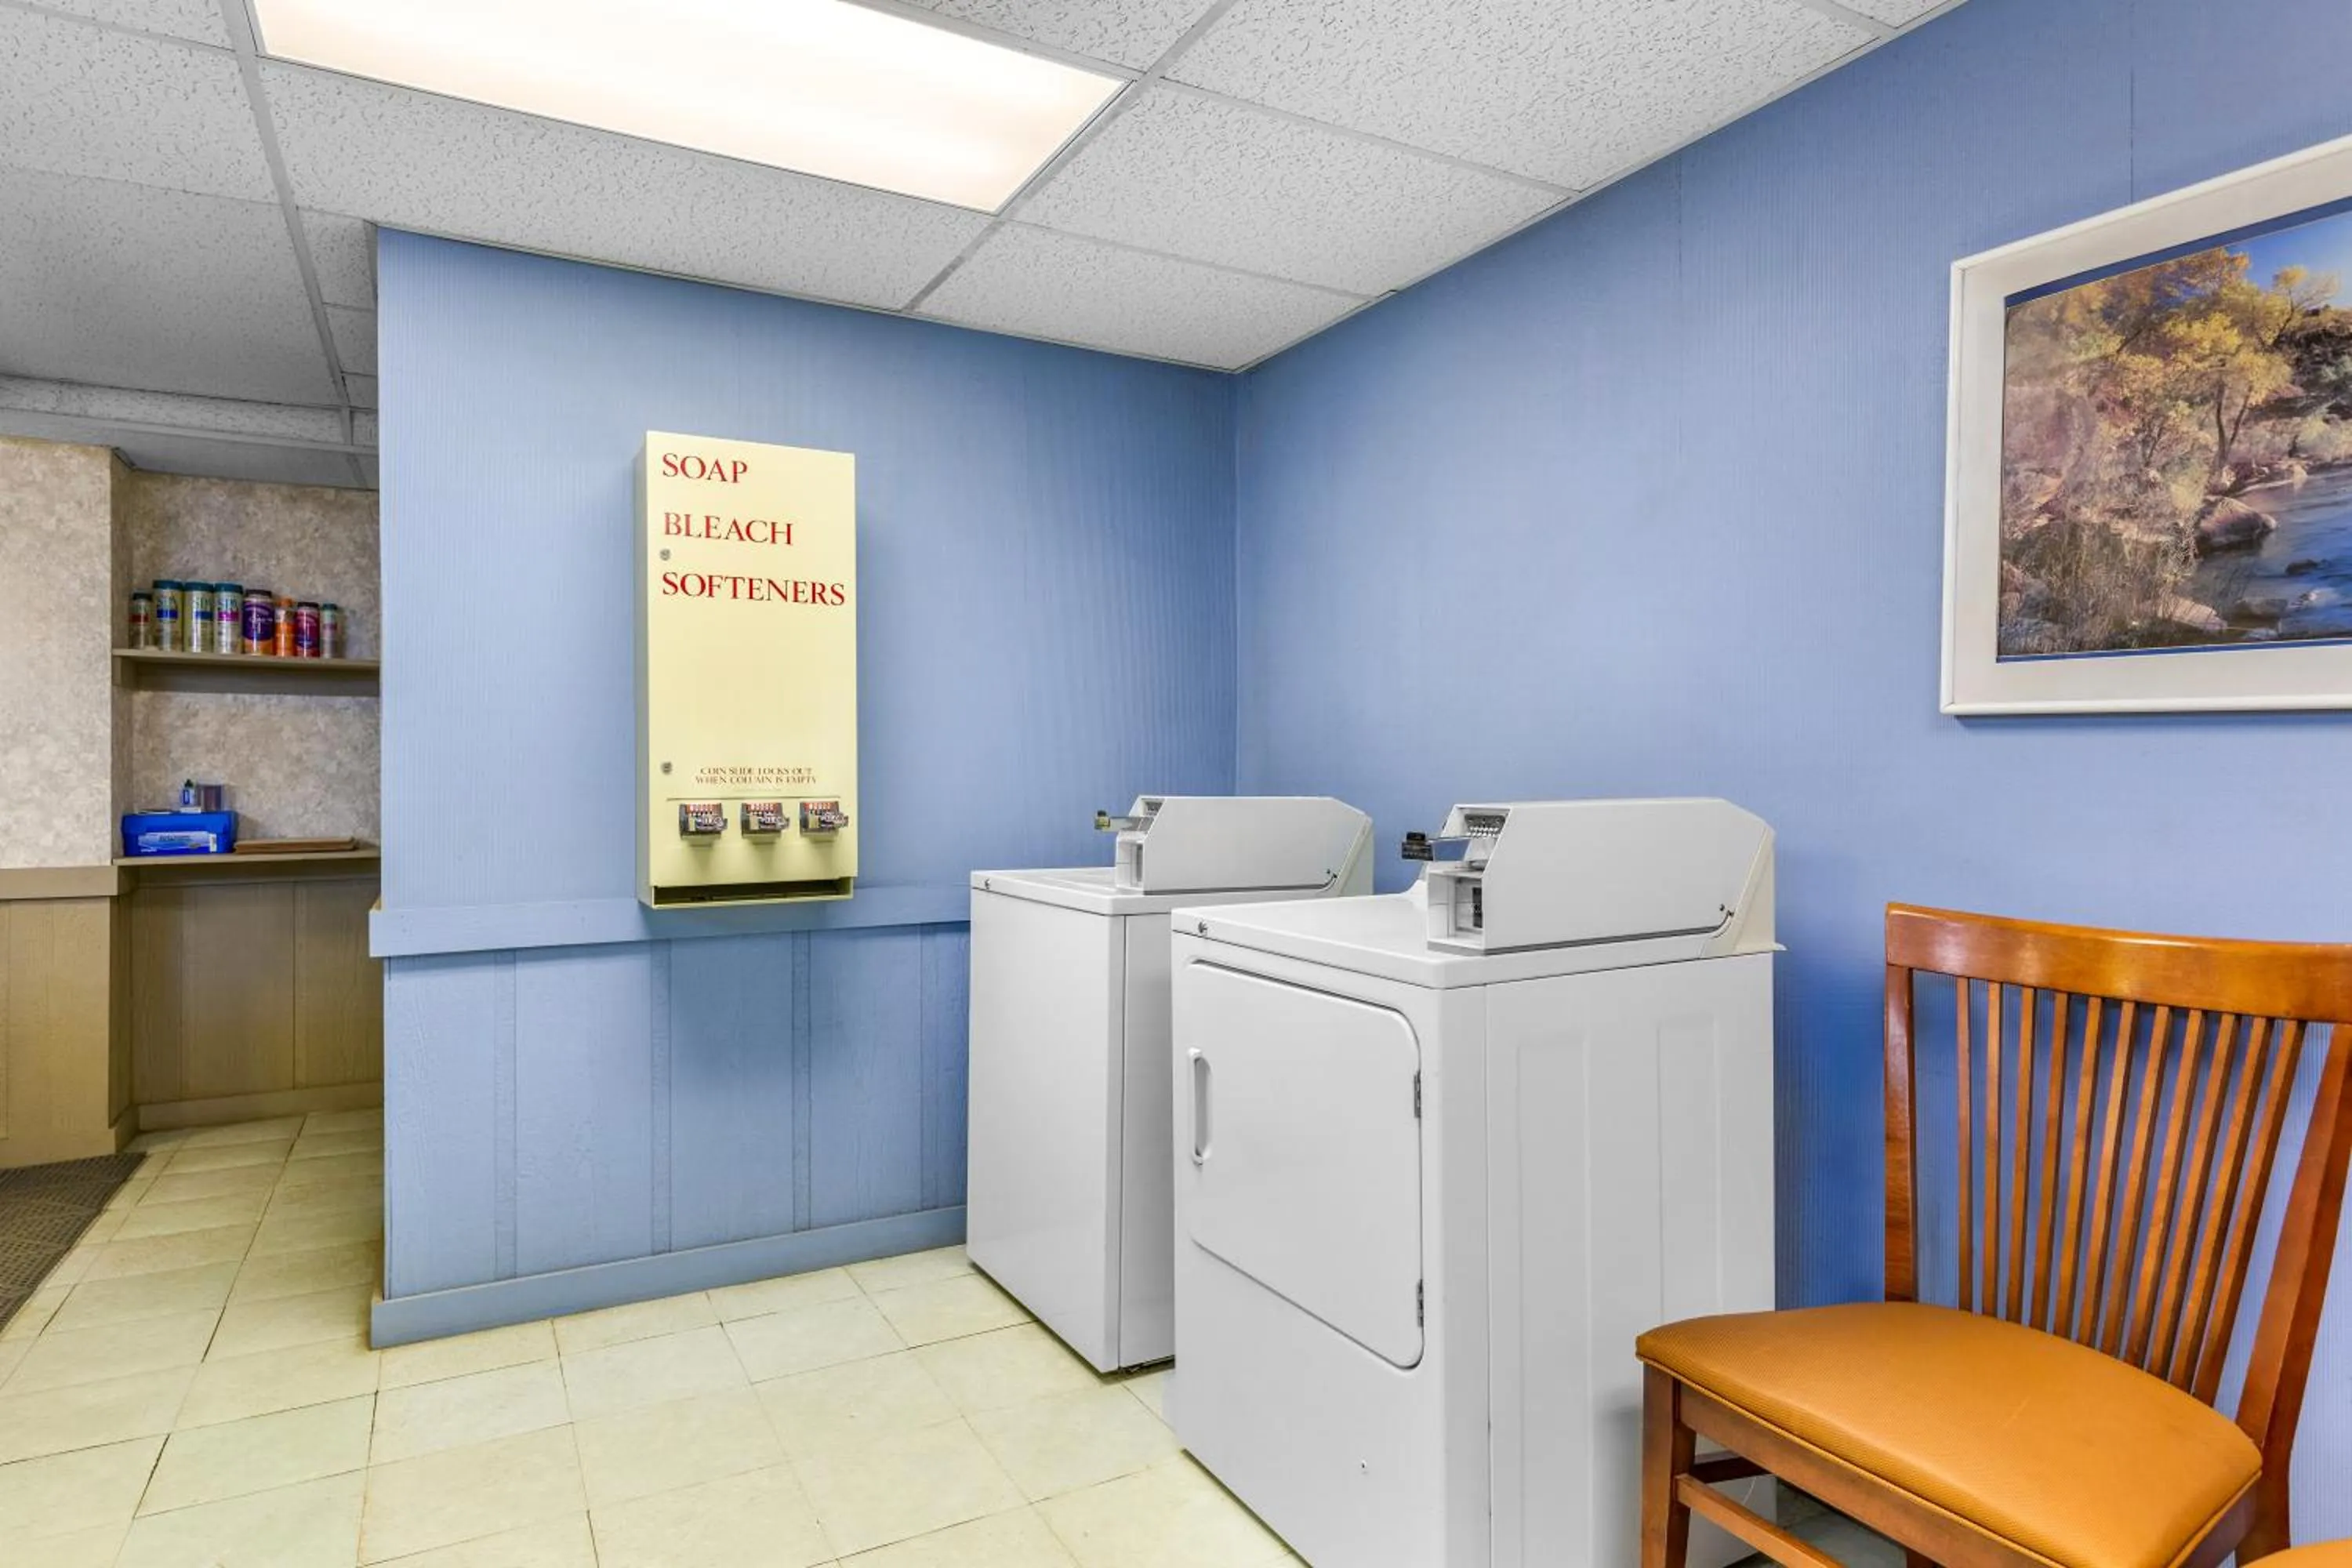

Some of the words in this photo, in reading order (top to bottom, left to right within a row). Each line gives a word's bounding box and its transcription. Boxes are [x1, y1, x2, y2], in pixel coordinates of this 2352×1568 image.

[662, 452, 747, 484] SOAP
[664, 512, 793, 546] BLEACH
[662, 572, 845, 606] SOFTENERS
[695, 775, 727, 784] WHEN
[730, 775, 772, 784] COLUMN
[775, 775, 783, 784] IS
[786, 775, 816, 784] EMPTY
